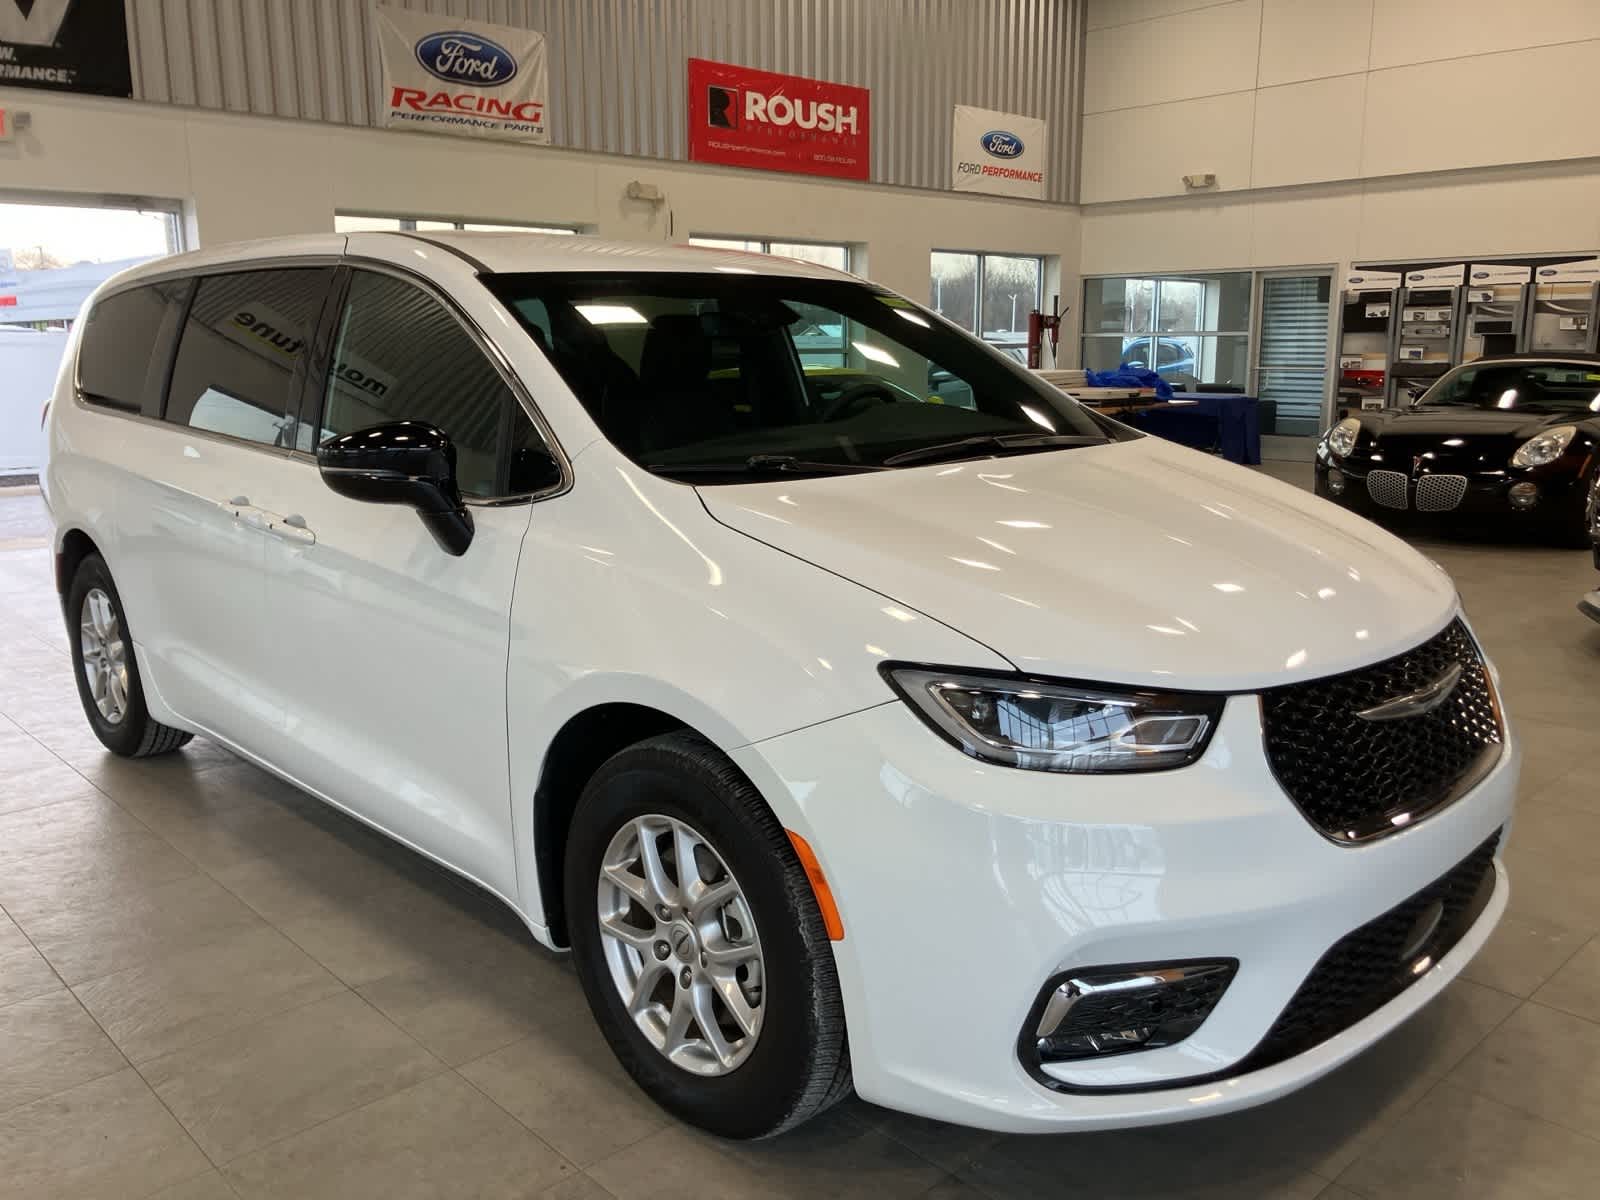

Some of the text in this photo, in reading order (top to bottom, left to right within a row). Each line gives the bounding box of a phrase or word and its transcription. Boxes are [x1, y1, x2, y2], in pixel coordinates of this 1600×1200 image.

[436, 38, 498, 80] Ford
[391, 86, 543, 123] RACING
[745, 90, 860, 135] ROUSH
[391, 111, 544, 134] PERFORMANCE PARTS
[989, 134, 1018, 155] Ford
[957, 162, 1043, 183] FORD PERFORMANCE
